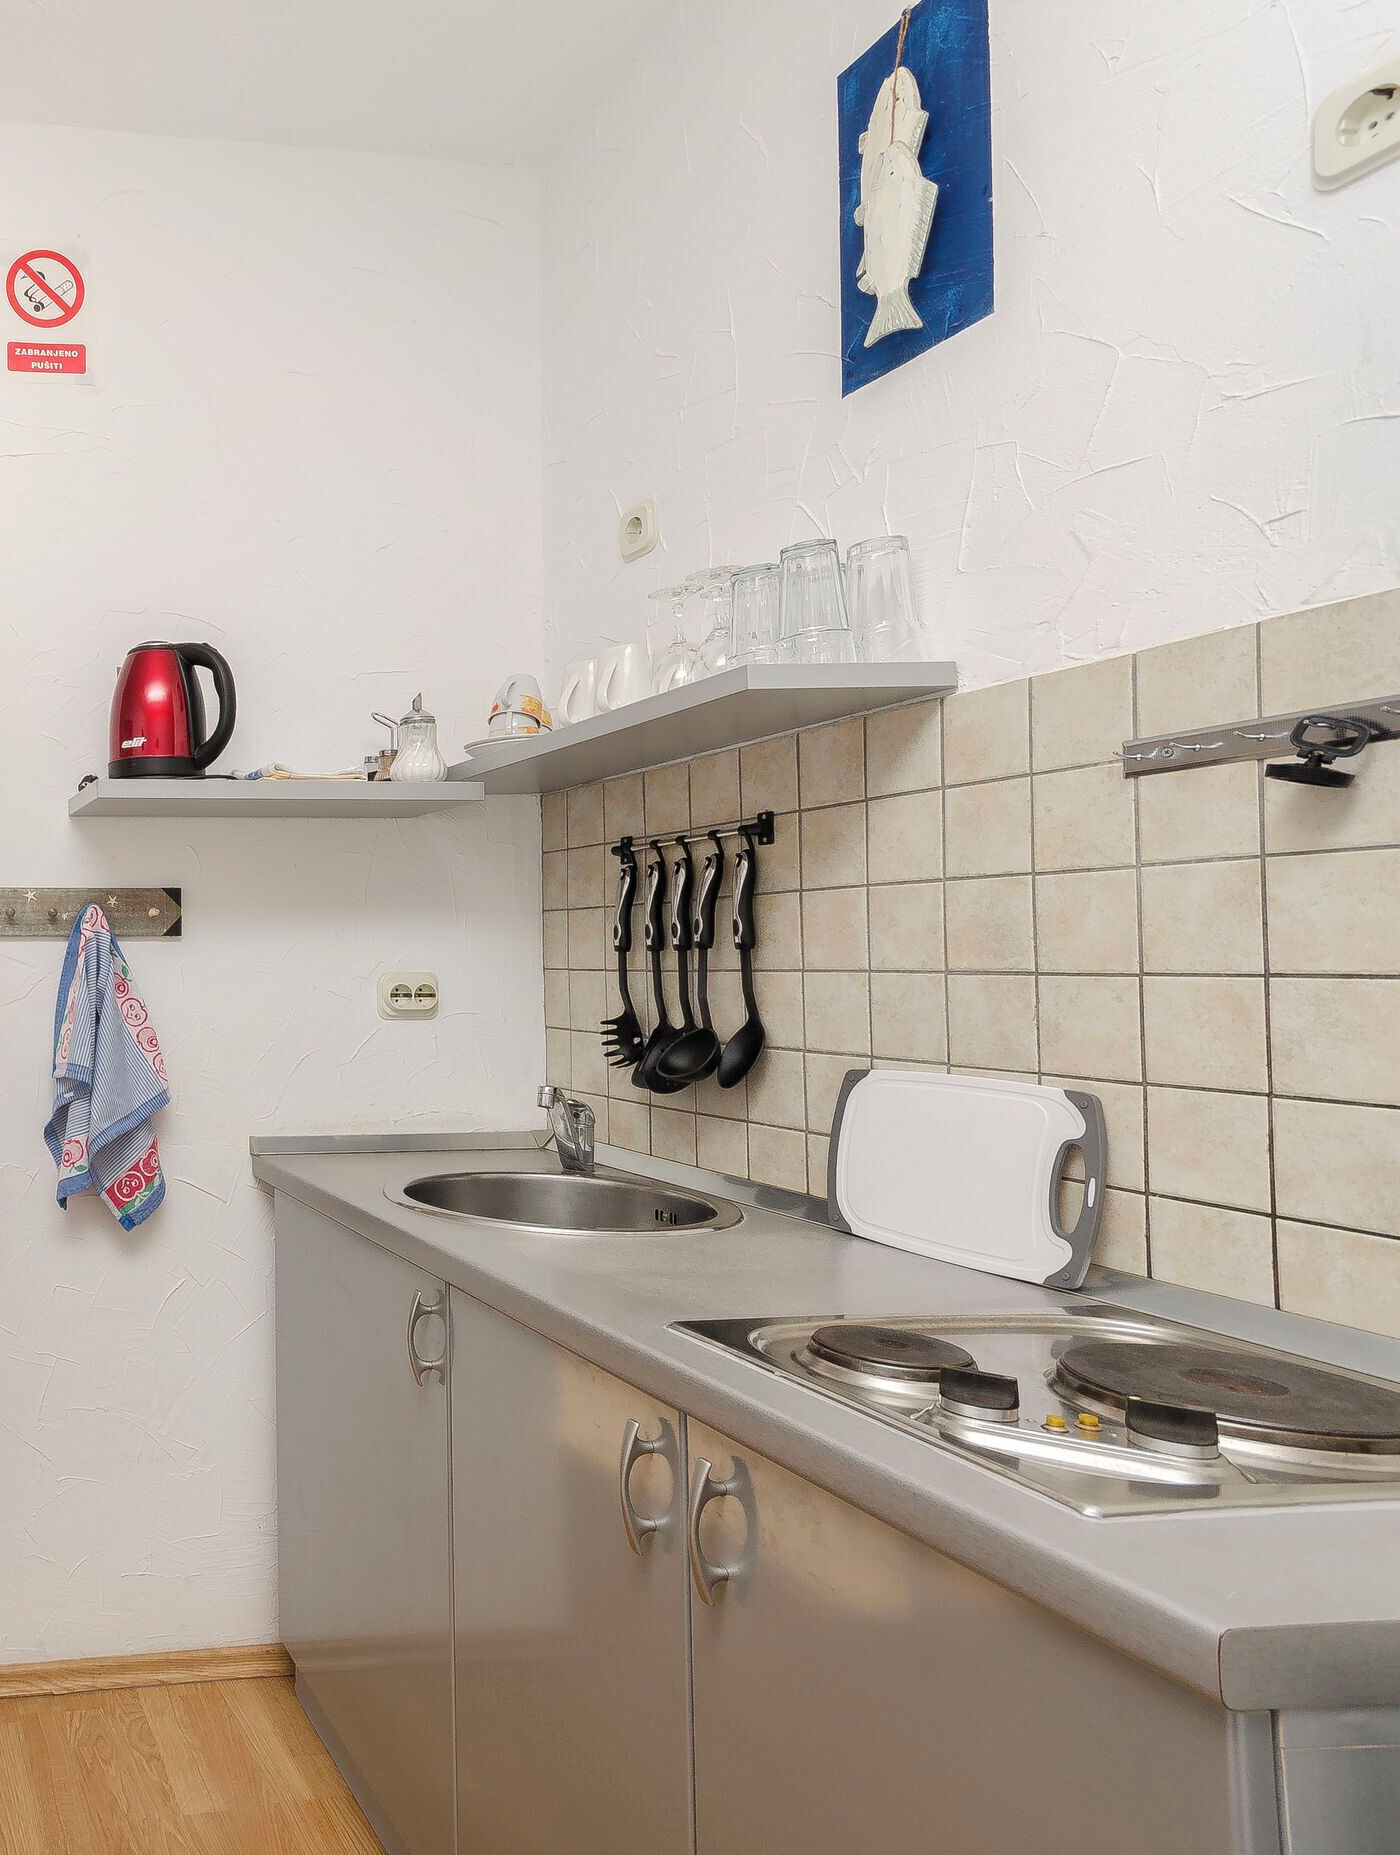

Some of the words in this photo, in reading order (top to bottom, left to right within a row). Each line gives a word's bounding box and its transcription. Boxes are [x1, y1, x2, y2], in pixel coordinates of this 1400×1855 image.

[14, 347, 79, 358] ZABRANJENO
[31, 360, 63, 370] PUŠITI
[121, 736, 148, 749] elit
